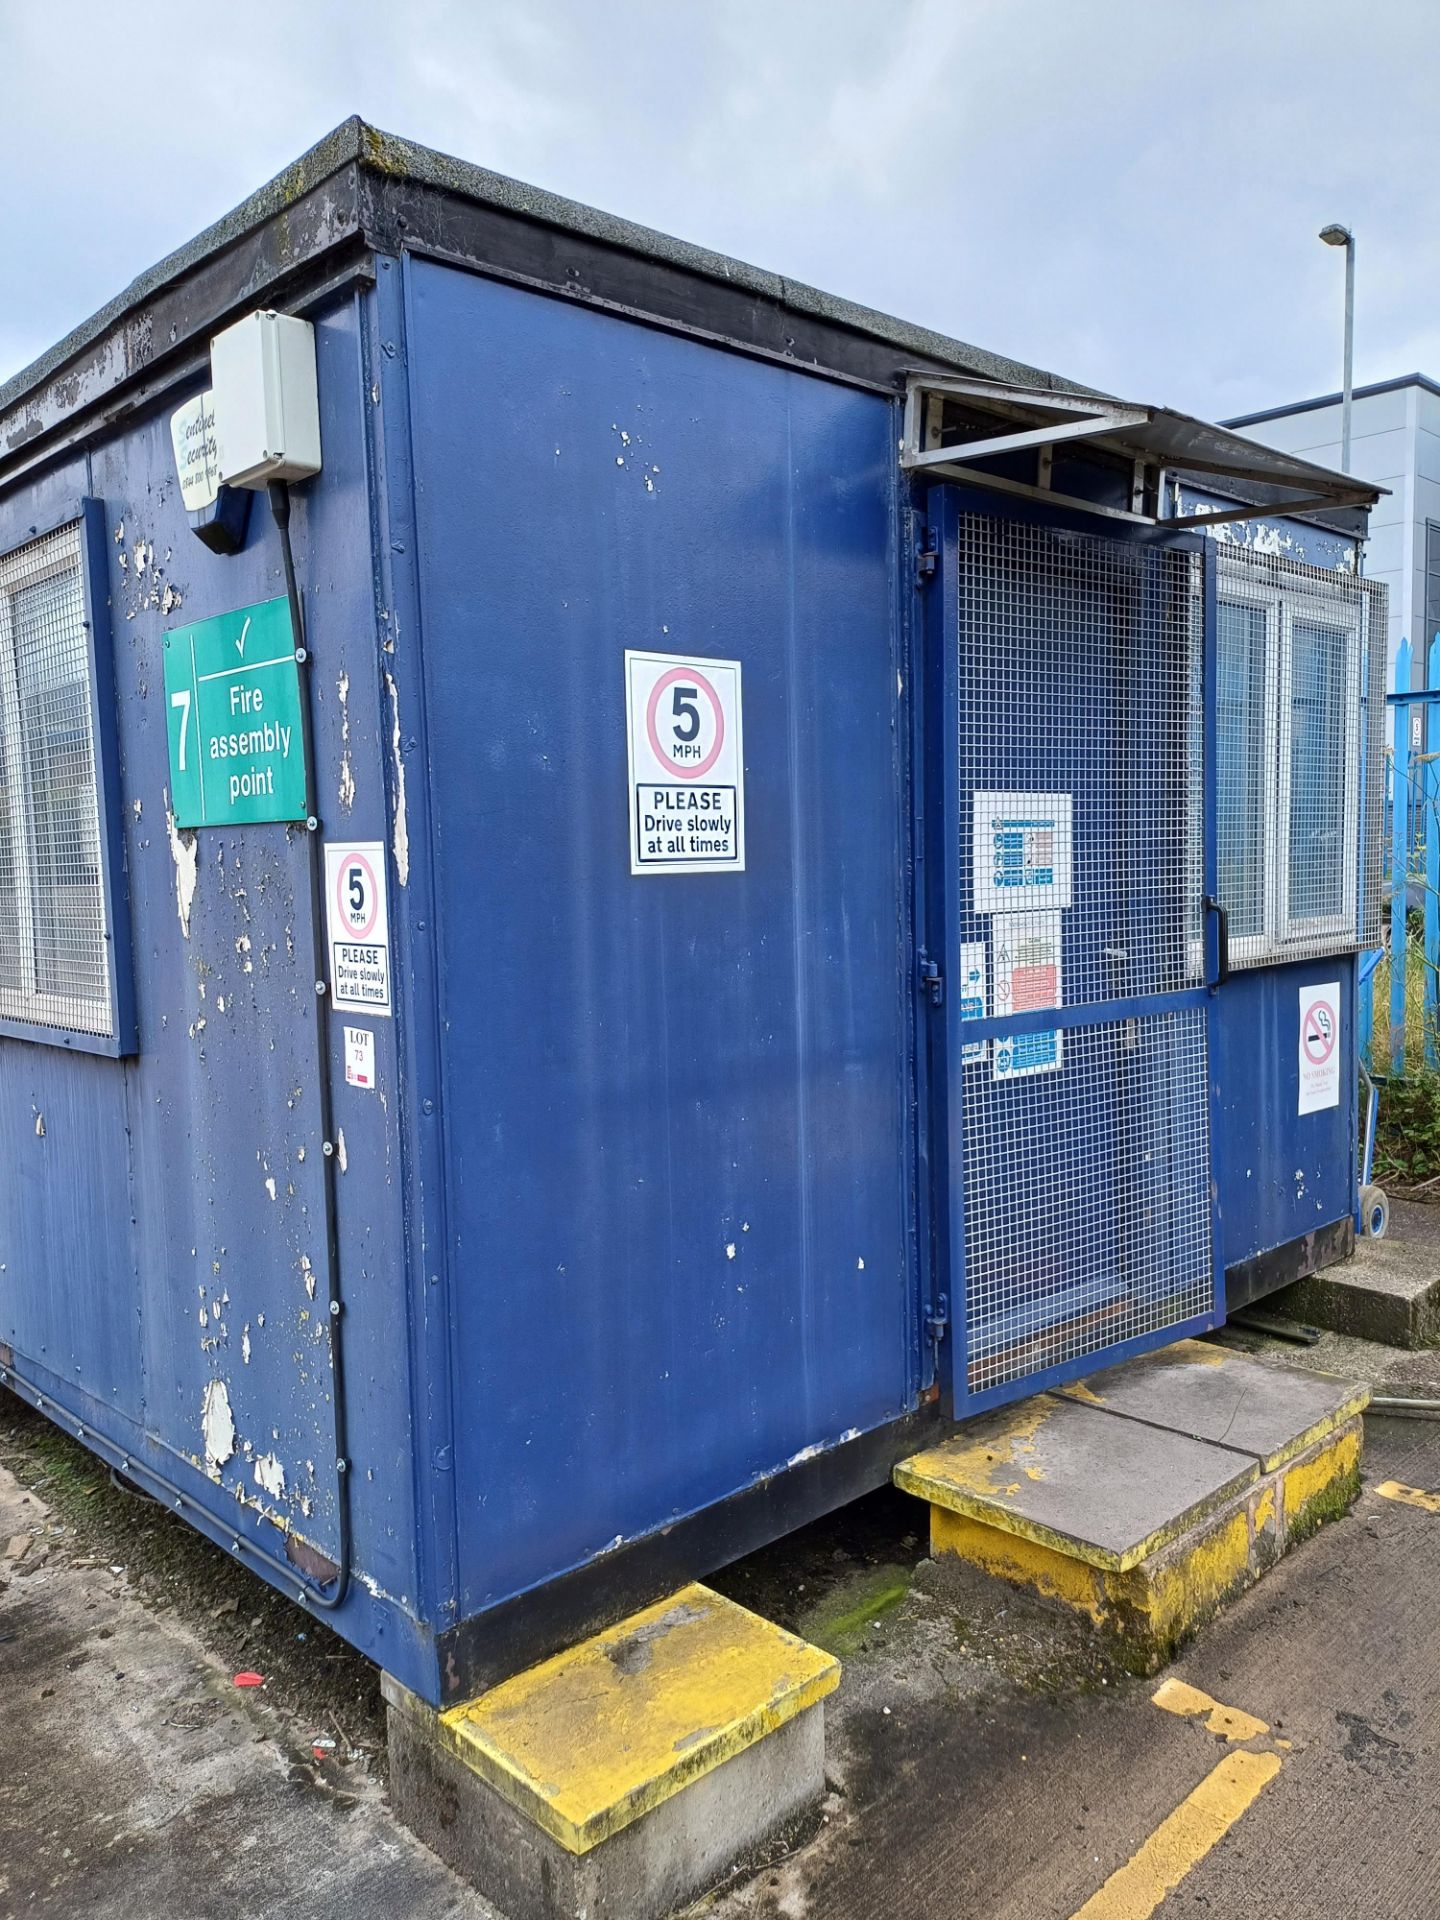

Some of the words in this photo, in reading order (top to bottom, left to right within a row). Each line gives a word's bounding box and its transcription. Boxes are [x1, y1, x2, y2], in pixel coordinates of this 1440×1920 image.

[229, 685, 264, 716] Fire
[672, 686, 701, 742] 5
[171, 690, 191, 771] 7
[210, 721, 291, 759] assembly
[673, 745, 701, 759] MPH
[229, 766, 274, 805] point
[654, 791, 722, 810] PLEASE
[644, 814, 683, 832] Drive
[687, 815, 732, 834] slowly
[647, 836, 663, 853] at
[667, 836, 686, 853] all
[690, 836, 729, 853] times
[349, 868, 365, 911] 5
[350, 912, 366, 925] MPH
[342, 948, 379, 964] PLEASE
[338, 965, 358, 980] Drive
[360, 967, 385, 985] slowly
[340, 982, 349, 995] at
[350, 982, 360, 996] all
[361, 984, 384, 999] times
[350, 1030, 369, 1046] LOT
[354, 1049, 364, 1062] 73
